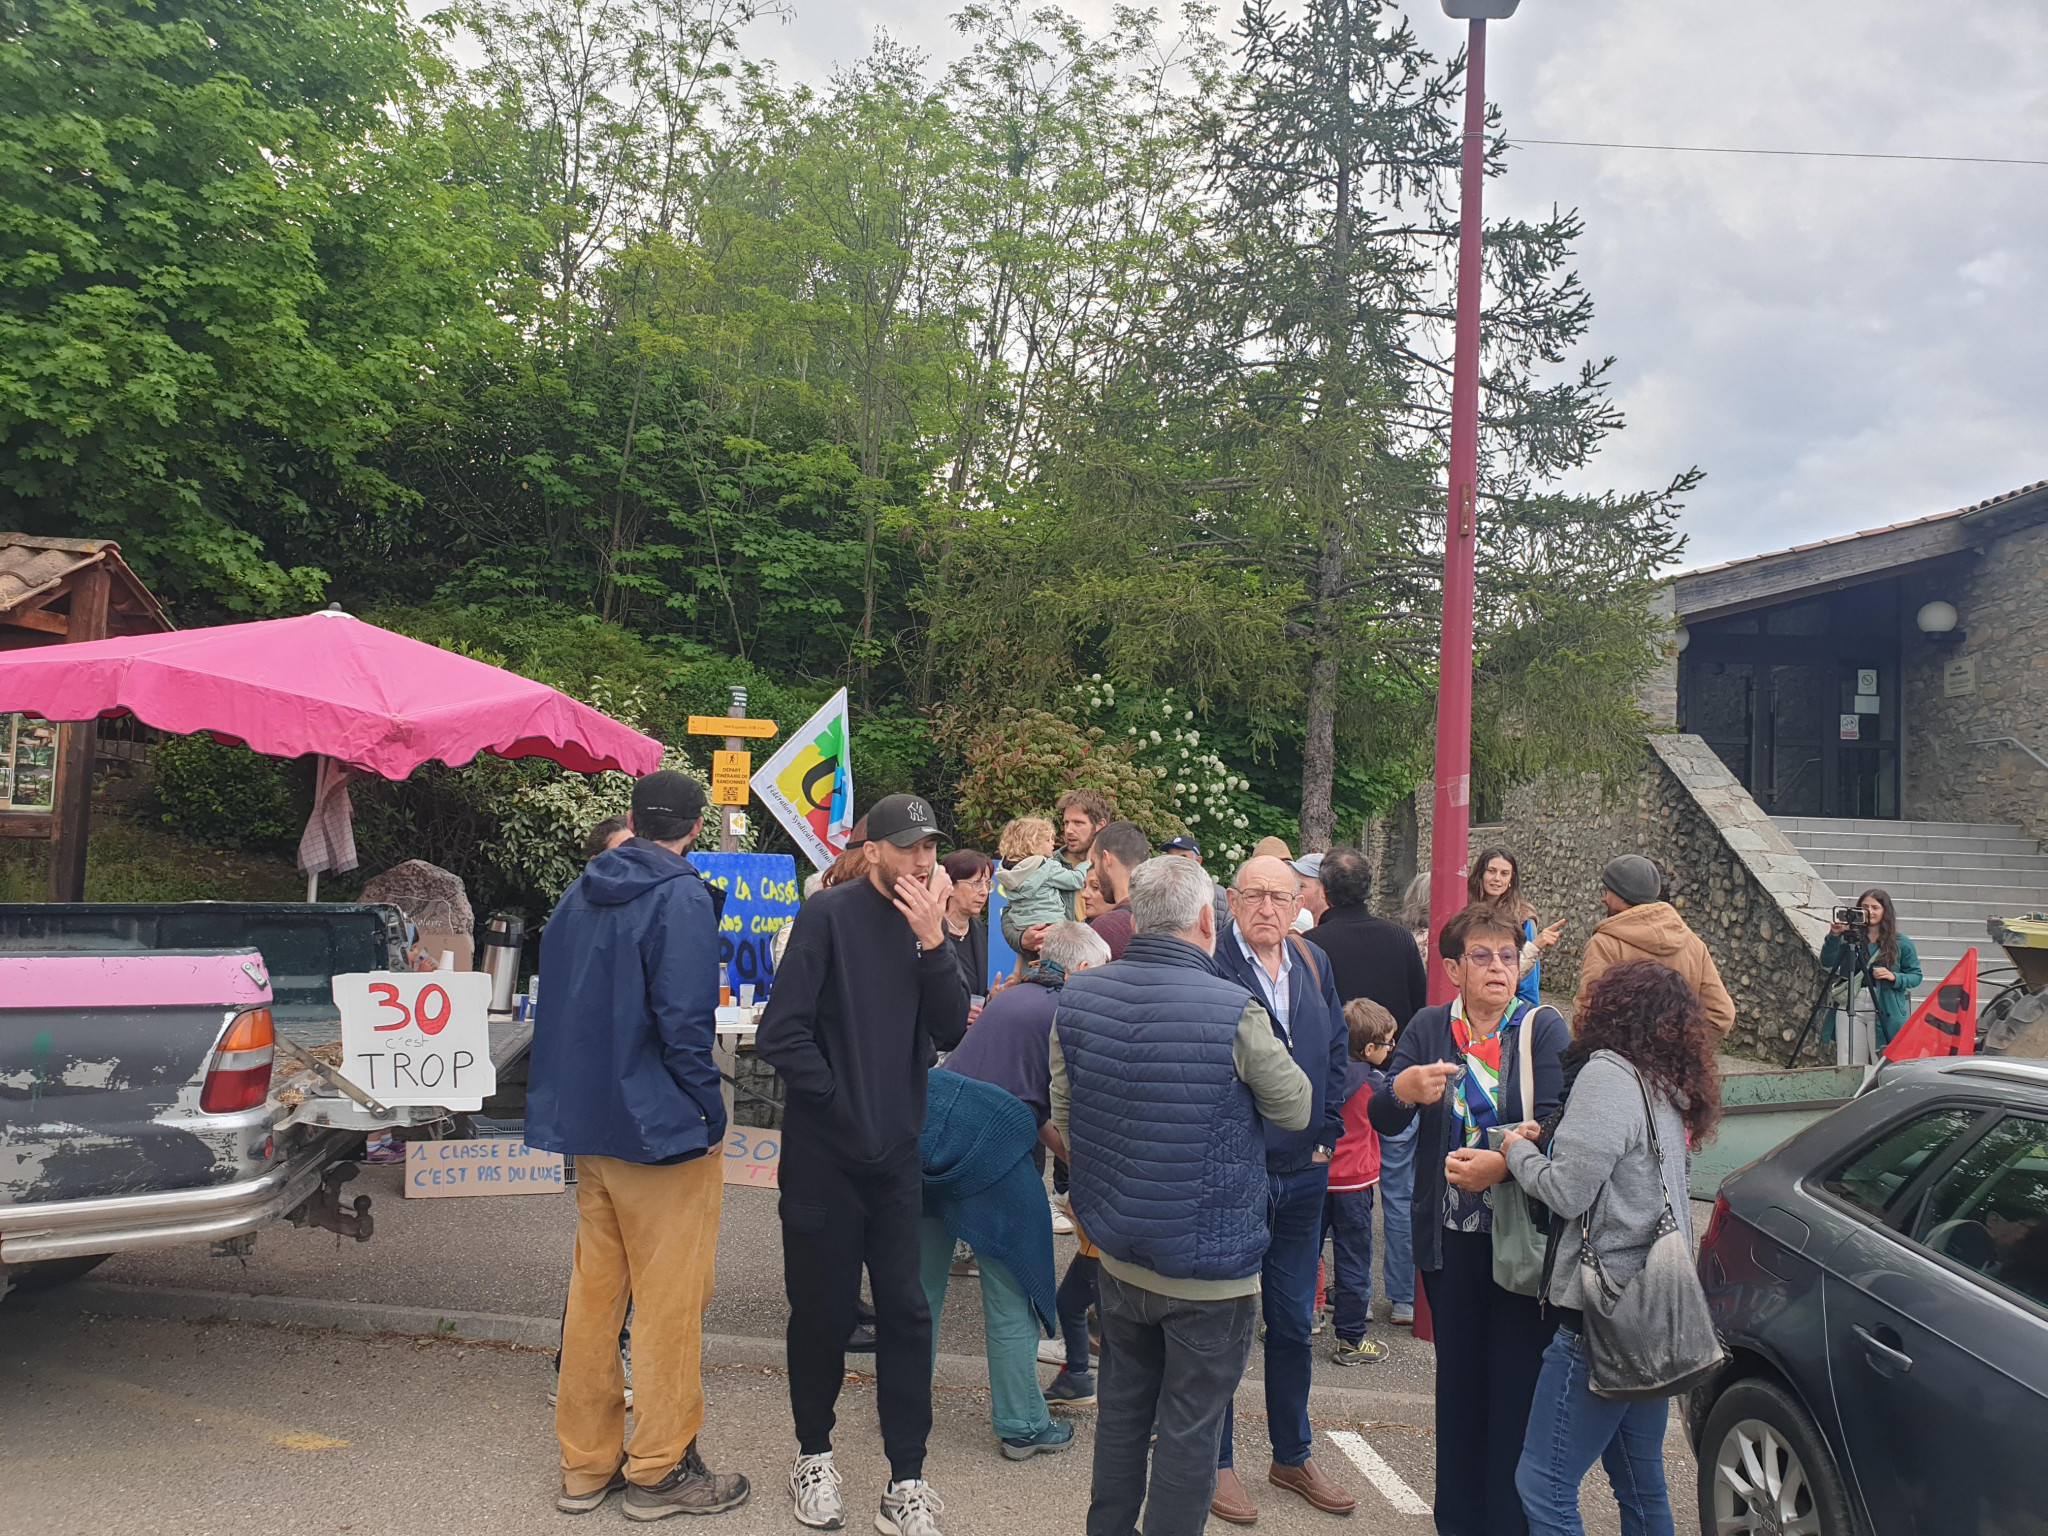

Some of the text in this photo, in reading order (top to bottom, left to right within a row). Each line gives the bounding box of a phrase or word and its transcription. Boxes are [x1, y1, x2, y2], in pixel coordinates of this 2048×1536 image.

[766, 784, 793, 815] Fédération
[791, 814, 815, 842] Syndicale
[735, 875, 752, 901] LA
[760, 877, 799, 905] CASSE
[368, 982, 451, 1035] 30
[385, 1033, 430, 1049] c'est
[357, 1050, 474, 1089] TROP
[411, 1146, 428, 1161] 1
[440, 1144, 506, 1160] CLASSE
[508, 1143, 531, 1158] EN
[723, 1131, 778, 1161] 30
[414, 1164, 562, 1187] C'EST PAS DU LUXE
